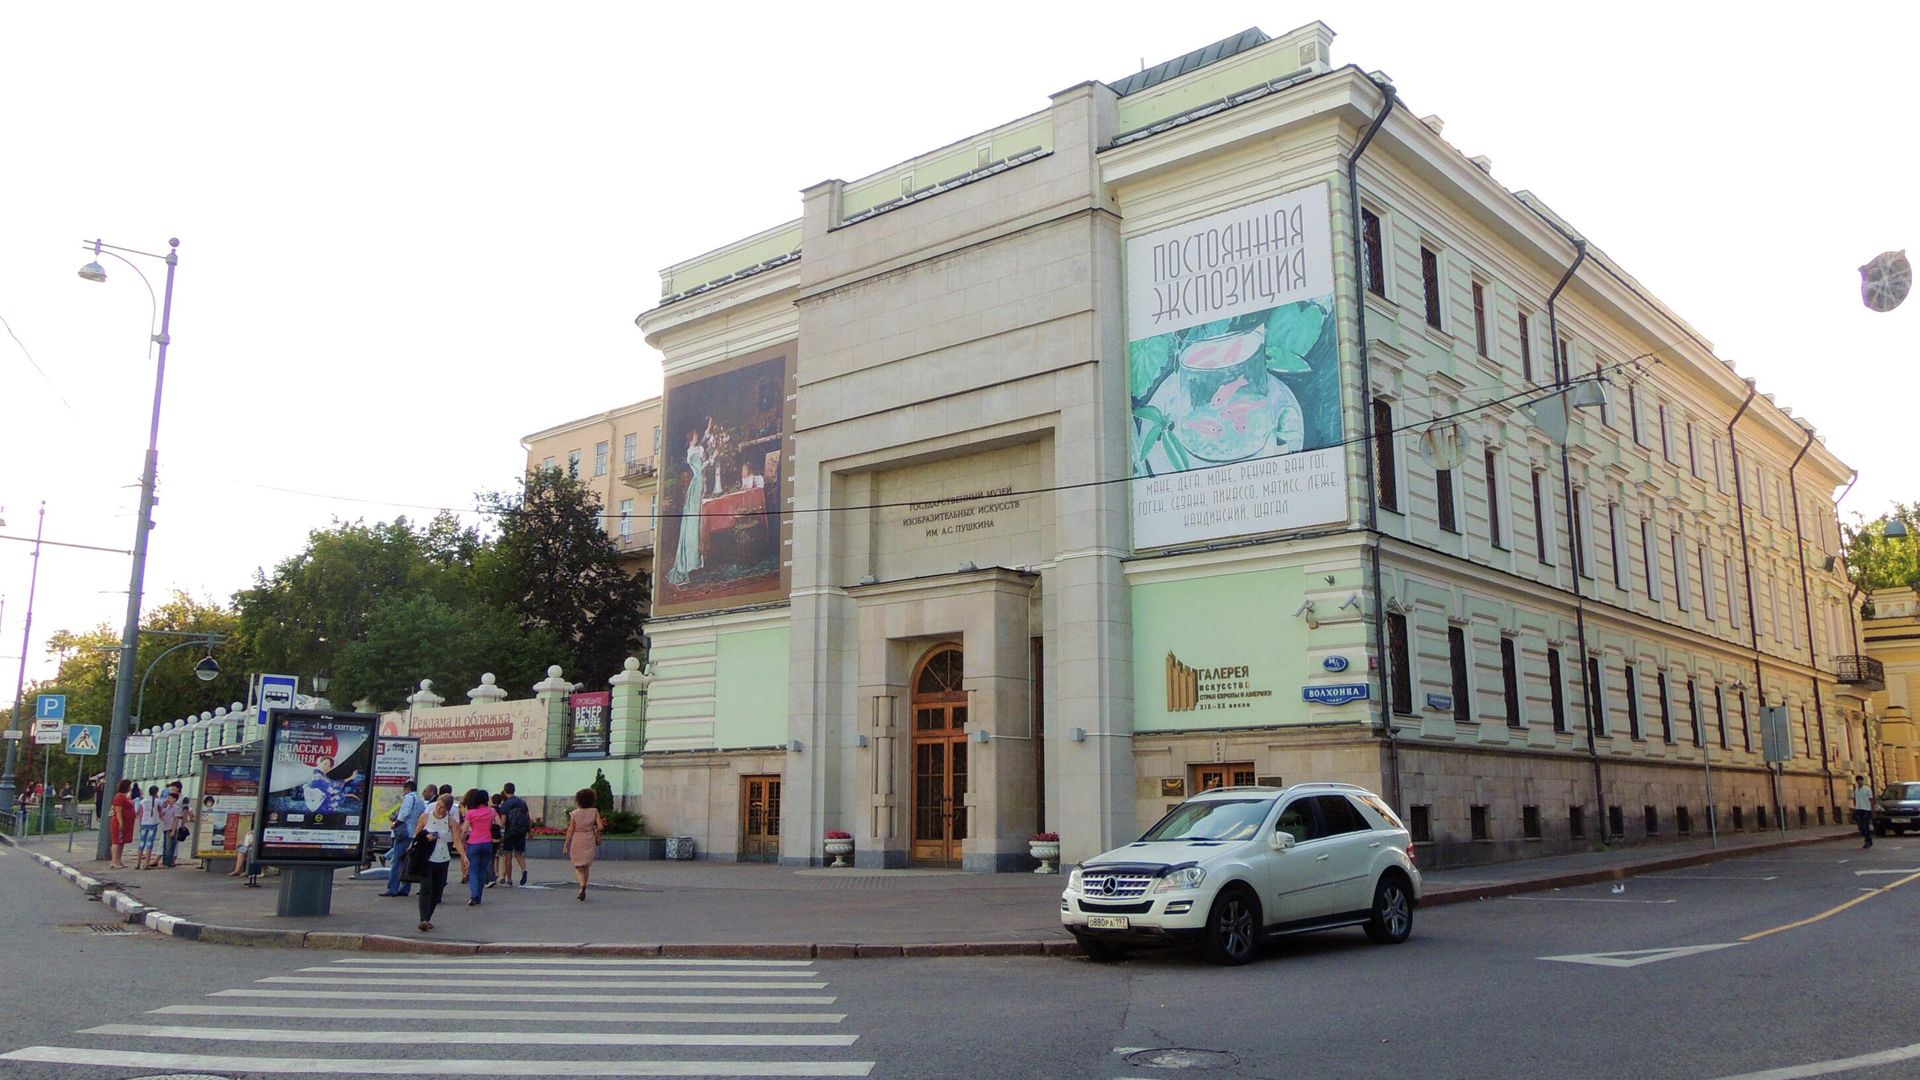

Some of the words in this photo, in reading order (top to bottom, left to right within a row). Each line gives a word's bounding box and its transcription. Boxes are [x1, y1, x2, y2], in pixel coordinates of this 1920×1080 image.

[1153, 203, 1304, 283] ПОСТОЯННАЯ
[1152, 247, 1306, 324] ЭКСПОЗИЦИЯ
[1284, 457, 1305, 474] ВАН
[903, 507, 975, 527] ИЗОБРАЗИТЕЛЬНЫХ
[978, 500, 1020, 514] ИСКУССТВ
[1253, 499, 1288, 519] ШАГАЛ
[955, 519, 995, 533] ПУШКИНА
[1199, 665, 1249, 681] ГАЛЕРЕЯ
[1309, 687, 1360, 698] ВОЛХОНКА
[575, 705, 602, 719] ВЕЧЕР
[333, 723, 366, 732] СЕНТЯБРЯ
[412, 716, 453, 730] Реклама
[464, 711, 511, 727] обложка
[467, 725, 511, 741] журналов
[278, 742, 333, 755] СПАССКАЯ
[278, 753, 316, 764] БАШНЯ
